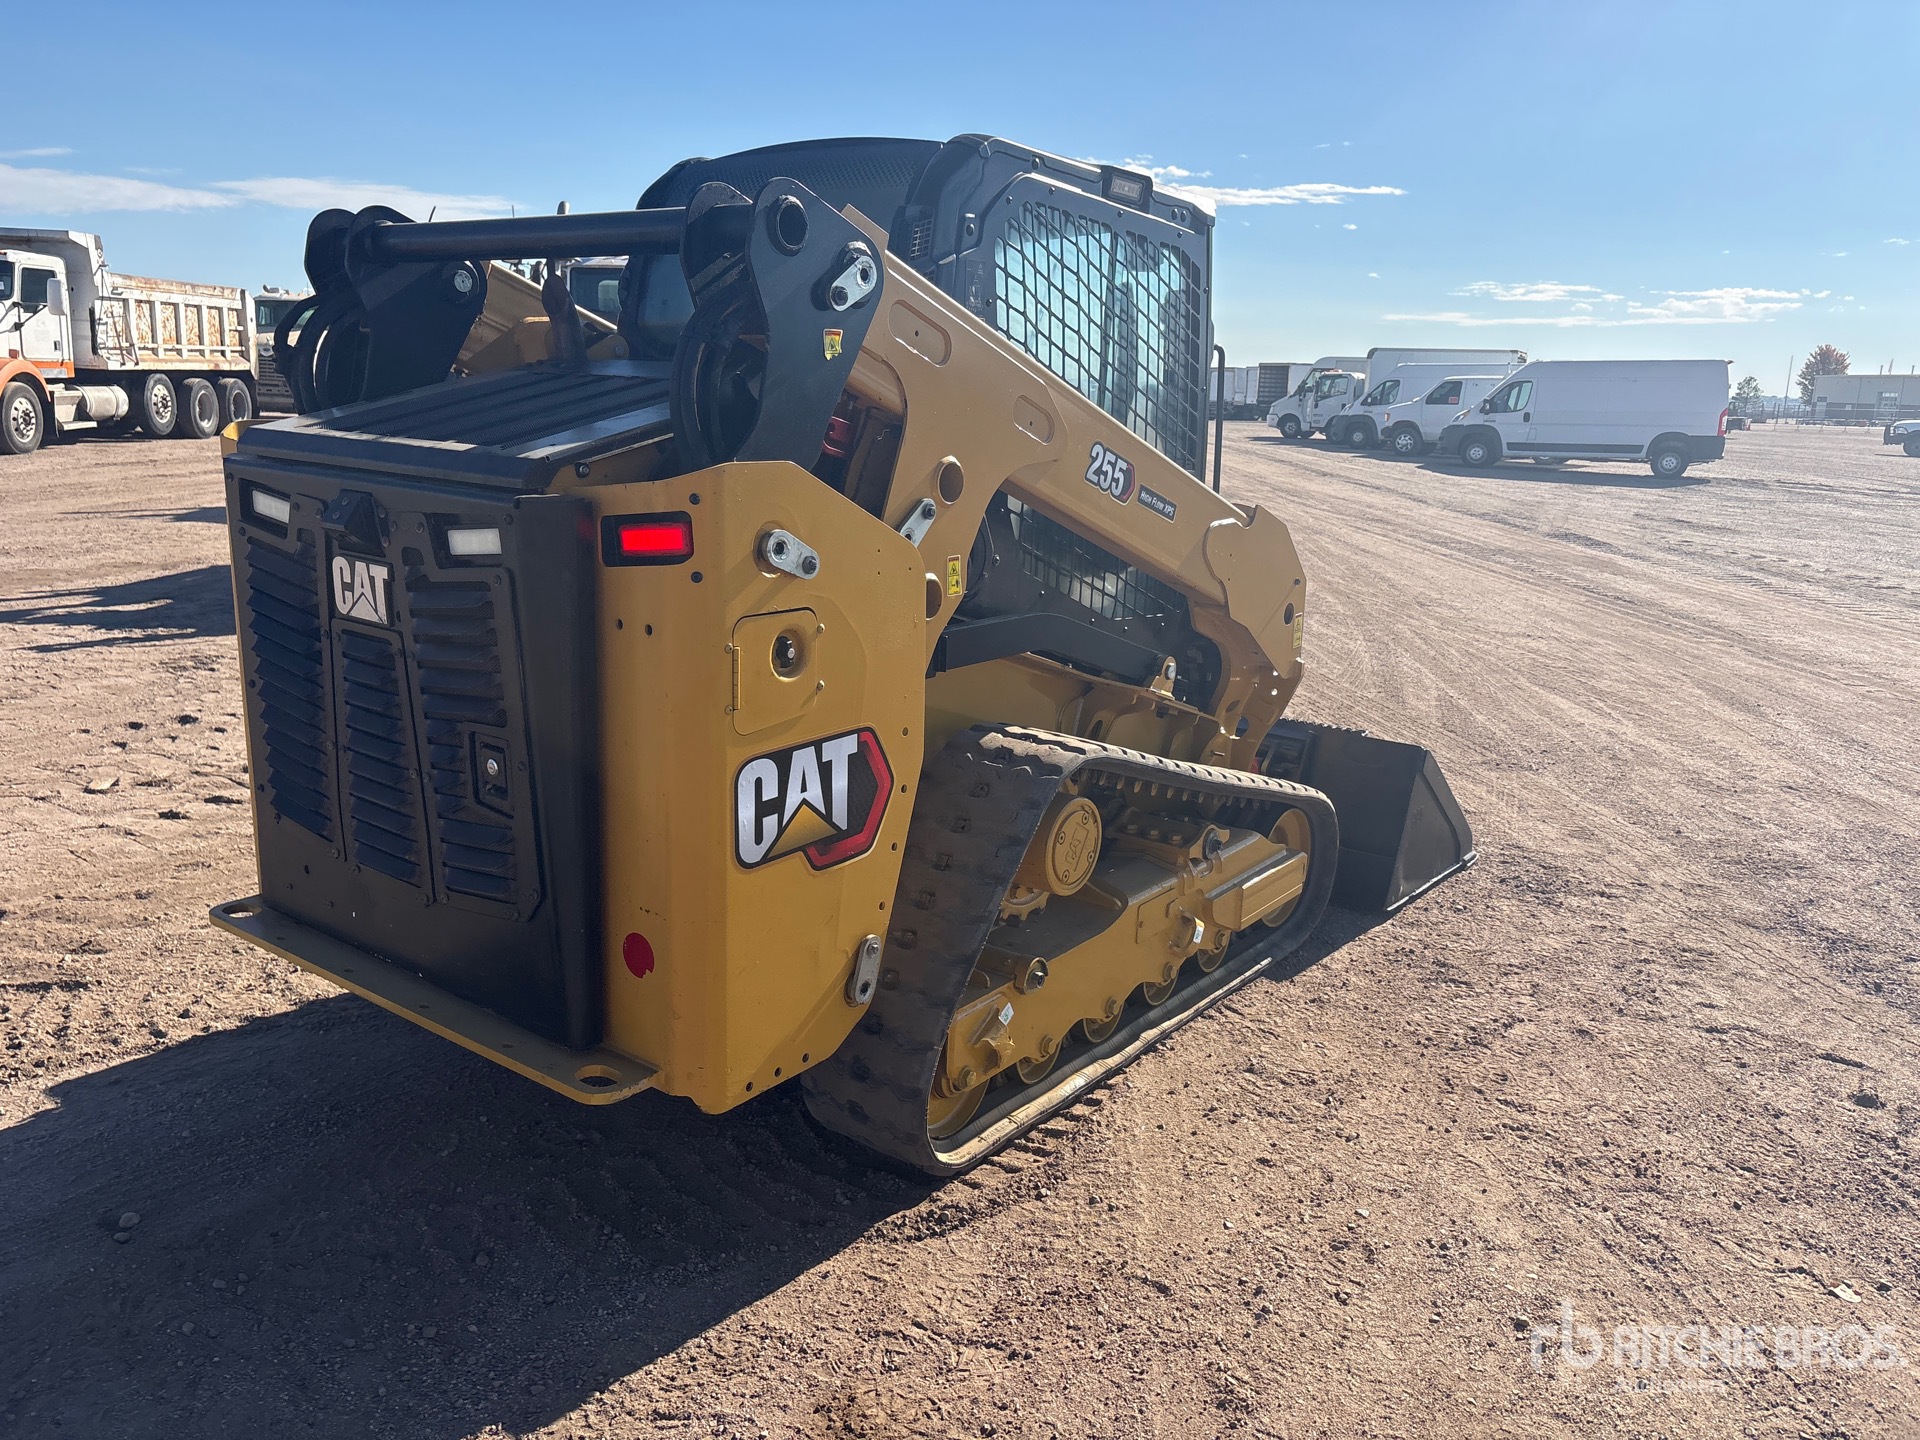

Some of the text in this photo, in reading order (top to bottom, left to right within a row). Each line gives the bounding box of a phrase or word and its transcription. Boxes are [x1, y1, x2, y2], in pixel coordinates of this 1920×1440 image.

[1086, 444, 1128, 496] 255
[1163, 503, 1175, 517] XPS
[332, 556, 389, 625] CAT
[737, 733, 858, 864] CAT
